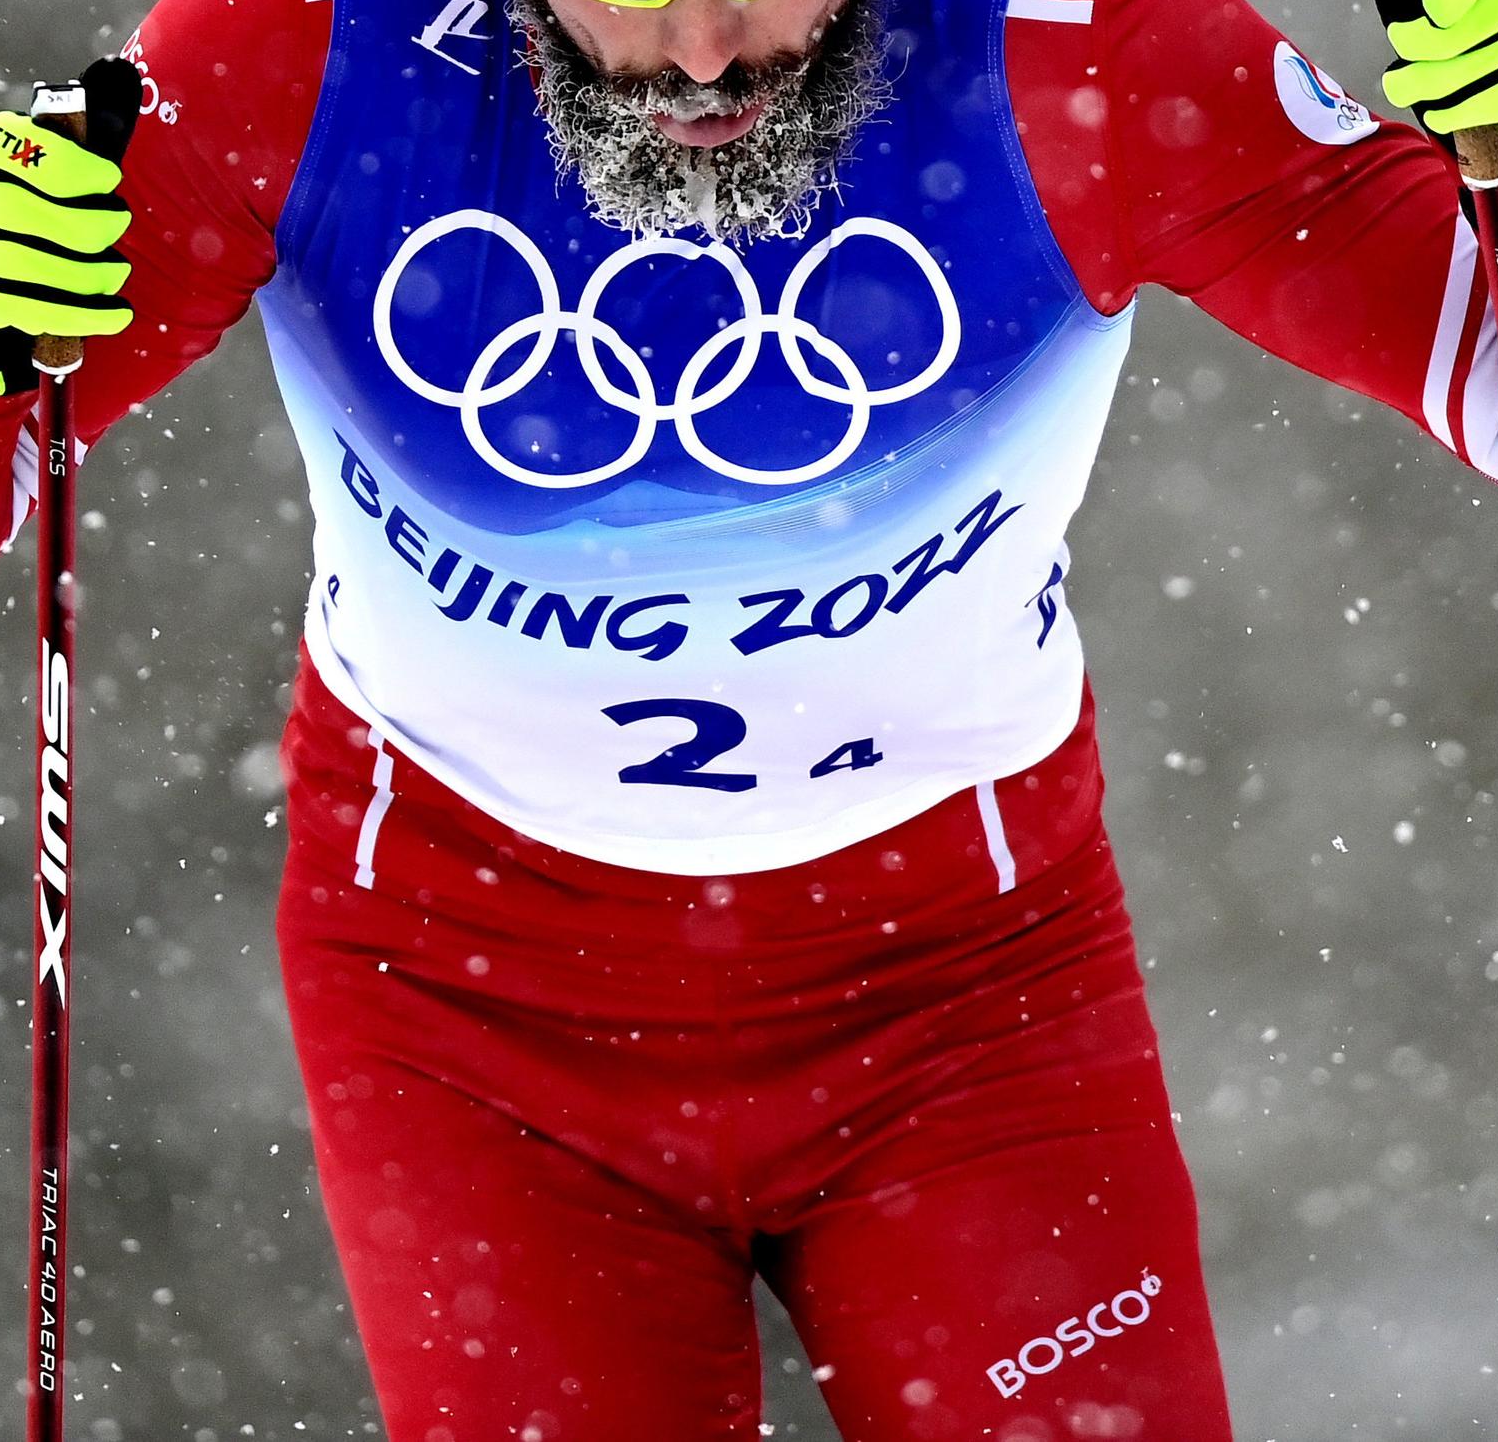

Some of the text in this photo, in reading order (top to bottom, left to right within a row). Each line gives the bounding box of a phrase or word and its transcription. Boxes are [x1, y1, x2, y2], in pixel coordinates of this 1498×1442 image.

[332, 426, 1025, 662] BEIJING 2022
[39, 637, 70, 1011] SWIX
[600, 698, 884, 793] 2 4
[39, 1167, 58, 1392] TRIAC 4.0 AERO
[985, 1288, 1151, 1399] BOSCO
